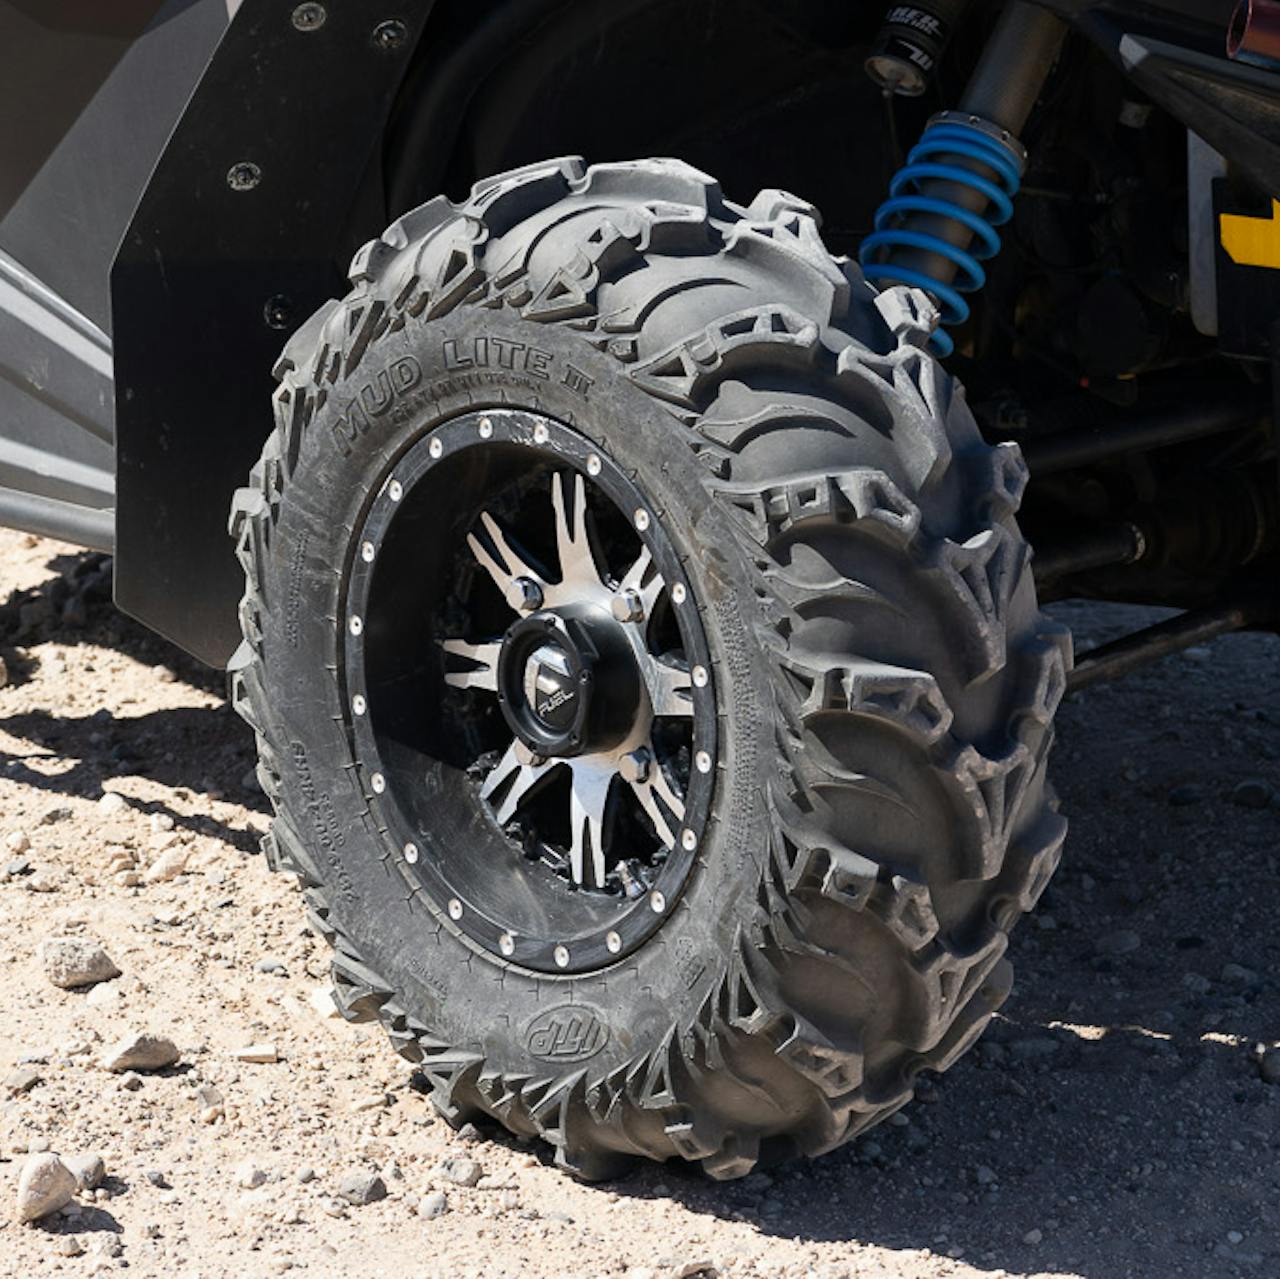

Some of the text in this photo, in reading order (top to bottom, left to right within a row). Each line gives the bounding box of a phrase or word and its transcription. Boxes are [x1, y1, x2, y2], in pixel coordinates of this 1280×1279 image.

[331, 354, 424, 458] MUD
[442, 337, 554, 380] LITE
[528, 1016, 602, 1056] ITP
